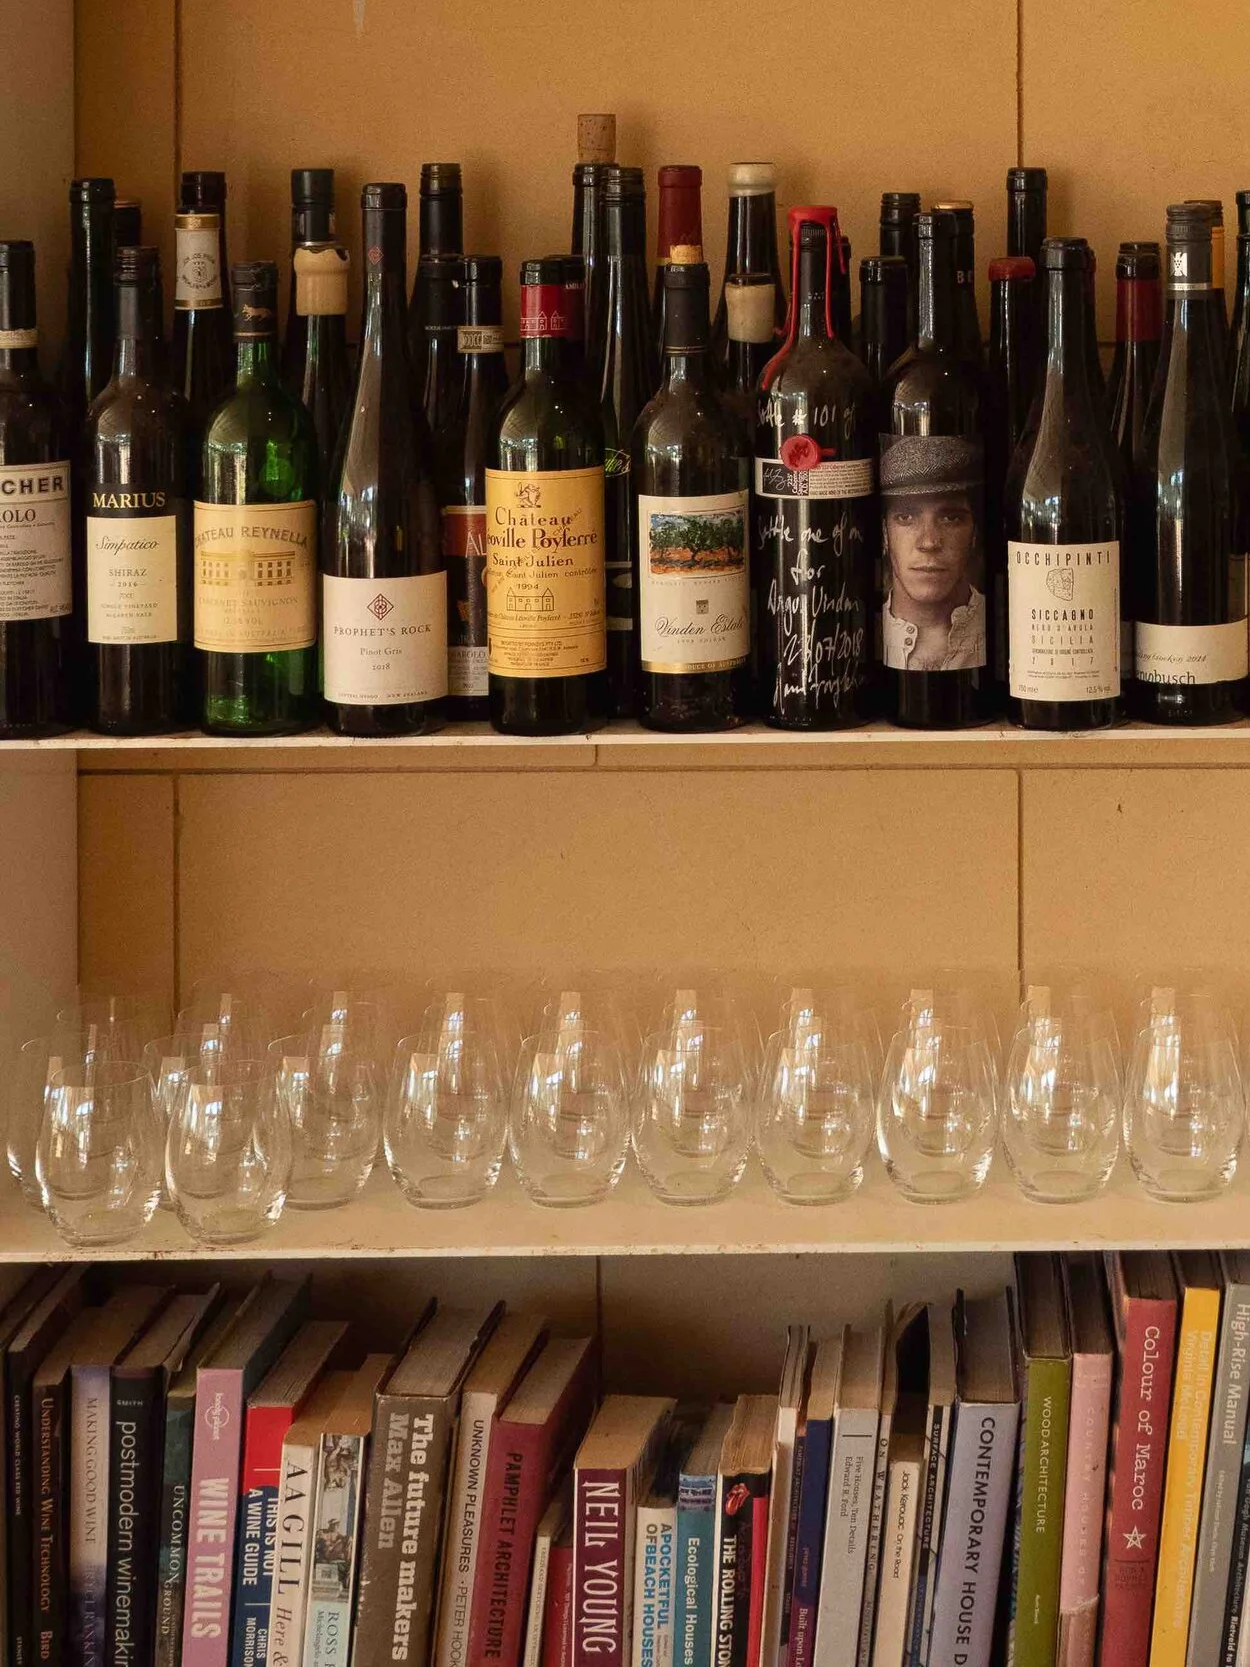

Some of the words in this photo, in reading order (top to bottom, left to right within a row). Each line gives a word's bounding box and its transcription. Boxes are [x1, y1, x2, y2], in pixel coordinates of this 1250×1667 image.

[93, 491, 165, 510] MARIUS
[495, 506, 572, 526] Château
[95, 535, 160, 556] Simpatico
[241, 526, 308, 546] REYNELLA
[525, 553, 574, 567] Julien
[531, 528, 597, 553] Poyferré
[1016, 551, 1111, 566] OCCHIPINTI
[109, 568, 147, 577] SHIRAZ
[334, 626, 396, 637] PROPHET'S
[401, 624, 432, 635] ROCK
[655, 616, 705, 637] Vinden
[1031, 608, 1094, 620] SICCAGNO
[1031, 635, 1094, 645] SICILIA
[360, 647, 382, 656] Pinot
[384, 646, 403, 656] Gris
[372, 663, 391, 671] 2018
[1140, 1324, 1160, 1401] Colour
[1229, 1303, 1250, 1380] High-Rise
[41, 1397, 55, 1495] UNDERSTANDING
[412, 1413, 434, 1466] The
[1039, 1396, 1052, 1437] WOOD
[1137, 1409, 1151, 1437] of
[1223, 1384, 1242, 1445] Manual
[116, 1421, 140, 1551] postmodern
[467, 1419, 485, 1490] UNKNOWN
[1131, 1442, 1151, 1512] Maroc
[196, 1477, 230, 1544] WINE
[378, 1477, 403, 1549] Allen
[402, 1472, 430, 1555] future
[500, 1452, 524, 1534] PAMPHLET
[584, 1481, 620, 1549] NEIL
[922, 1473, 936, 1550] ARCHITECTURE
[964, 1417, 996, 1575] CONTEMPORARY
[1034, 1439, 1050, 1534] ARCHITECTURE
[168, 1485, 185, 1584] UNCOMMON
[245, 1501, 263, 1539] WINE
[458, 1492, 477, 1574] PLEASURES
[722, 1534, 737, 1564] THE
[40, 1534, 54, 1613] TECHNOLOGY
[242, 1543, 260, 1586] GUIDE
[277, 1513, 305, 1595] GILL
[684, 1537, 700, 1609] Ecological
[191, 1552, 226, 1639] TRAILS
[276, 1606, 293, 1647] Here
[392, 1560, 418, 1662] makers
[485, 1539, 514, 1660] ARCHITECTURE
[582, 1559, 619, 1655] YOUNG
[719, 1568, 736, 1631] ROLLING
[958, 1582, 976, 1647] HOUSE
[325, 1610, 340, 1656] ROSS
[684, 1614, 698, 1665] Houses
